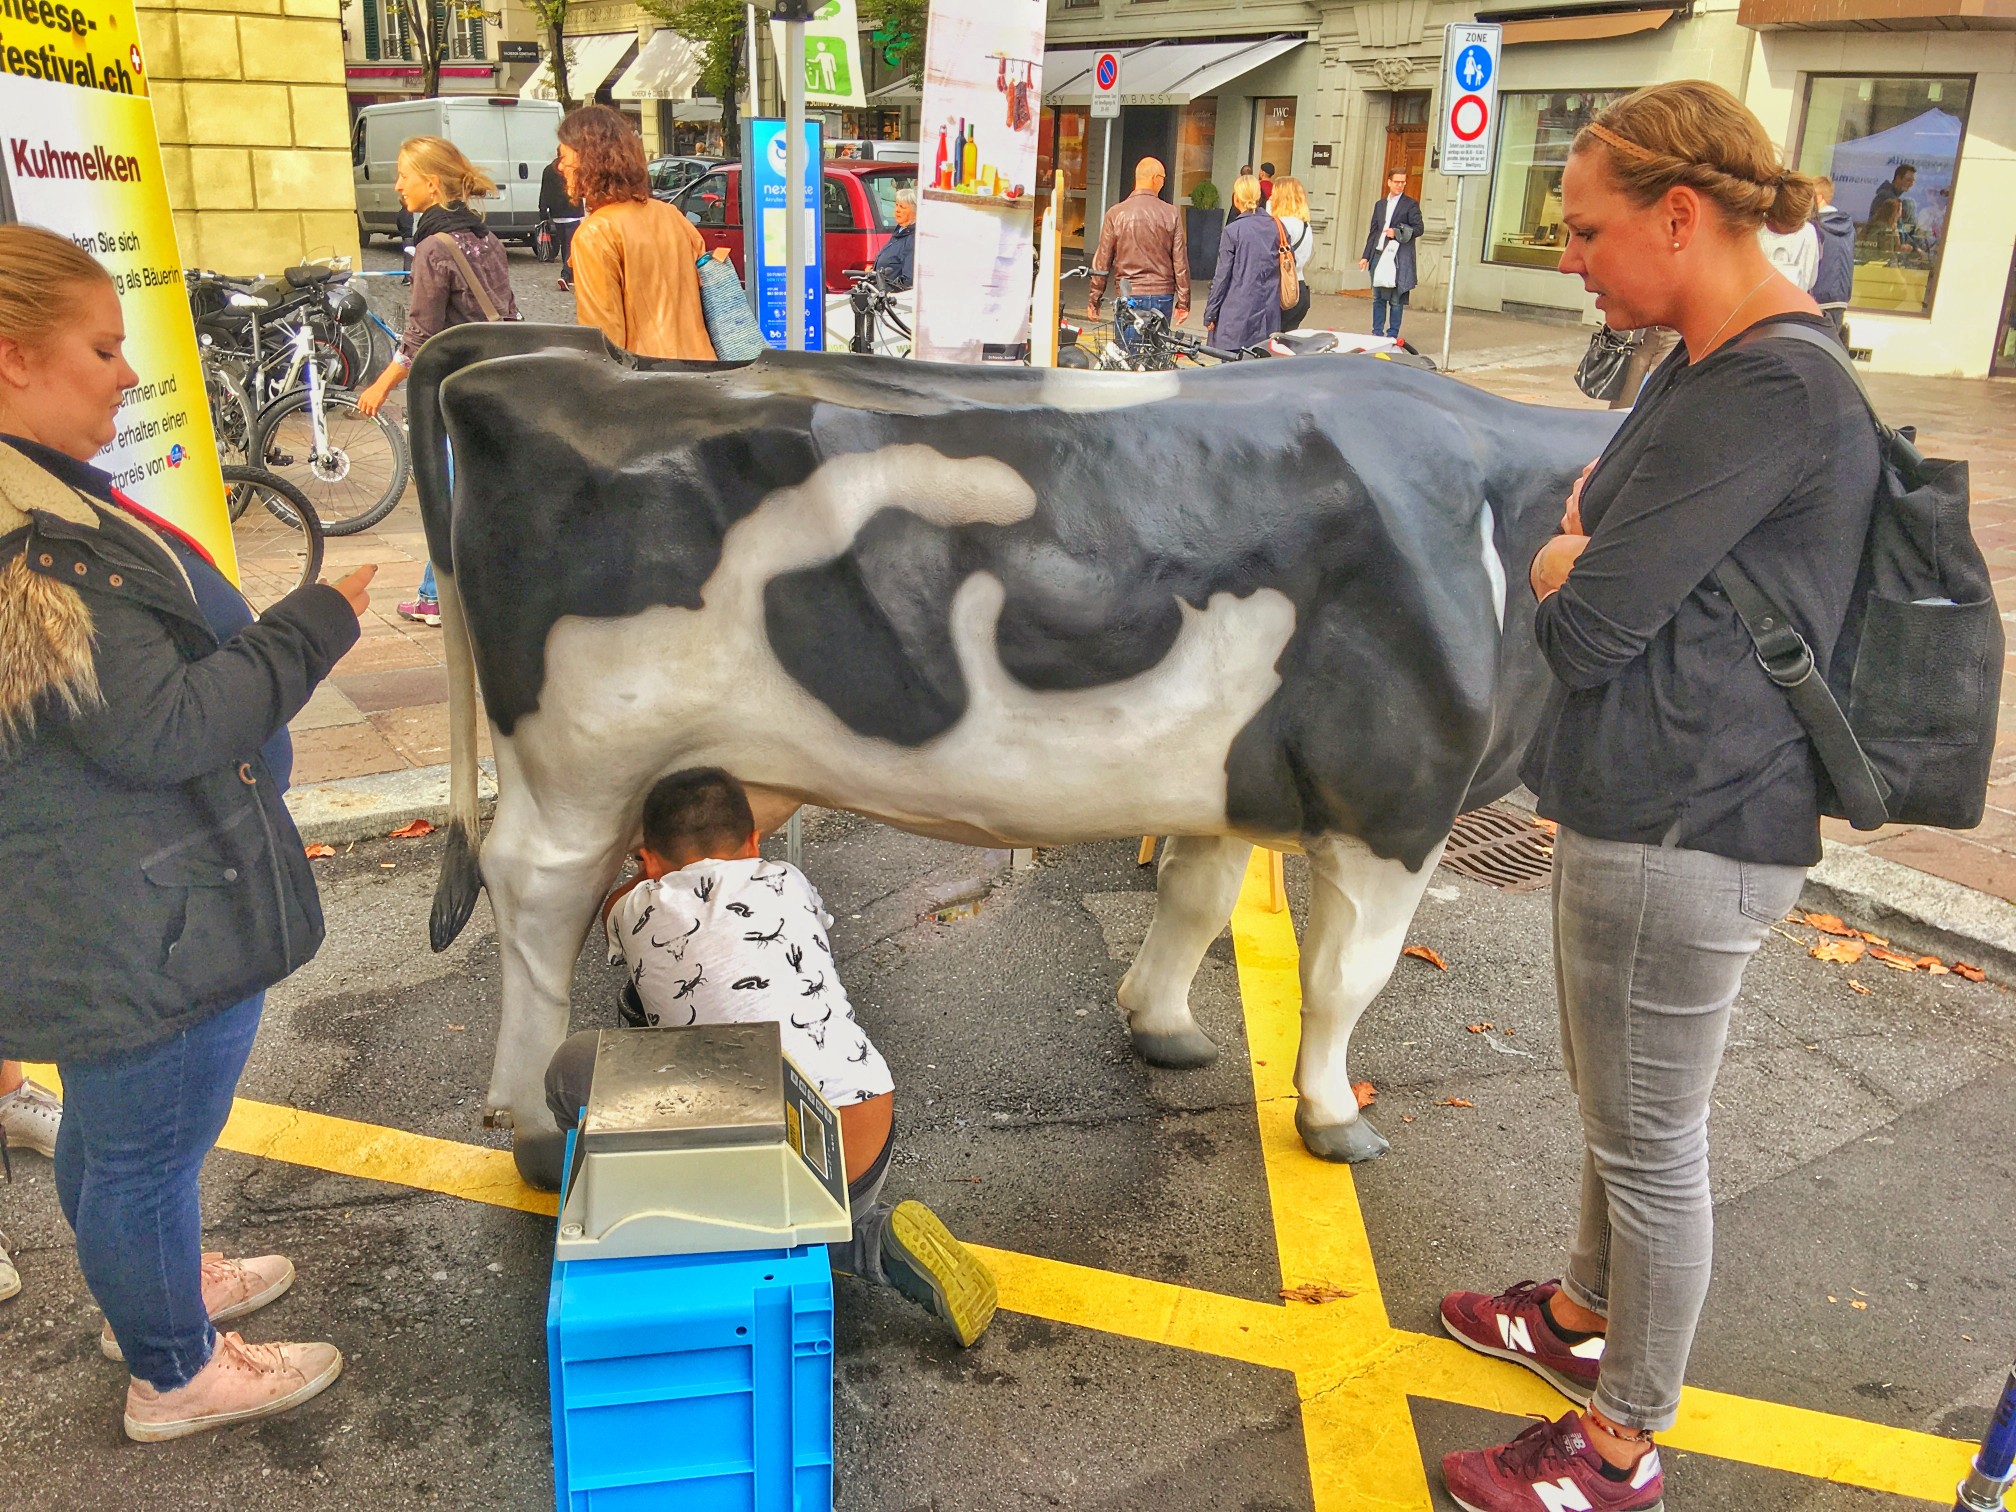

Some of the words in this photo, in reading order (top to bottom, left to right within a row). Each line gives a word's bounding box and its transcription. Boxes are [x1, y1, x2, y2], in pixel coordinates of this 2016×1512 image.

[1466, 32, 1488, 42] ZONE
[1120, 94, 1172, 104] MBASSY
[1273, 107, 1290, 118] IWC
[10, 138, 141, 182] Kuhmelken
[98, 232, 116, 252] Sie
[118, 231, 140, 251] sich
[126, 269, 142, 289] als
[143, 266, 180, 287] Bäuerin
[158, 374, 177, 396] und
[118, 420, 160, 448] erhalten
[162, 411, 188, 432] einen
[146, 457, 165, 476] von
[1496, 1314, 1536, 1354] N
